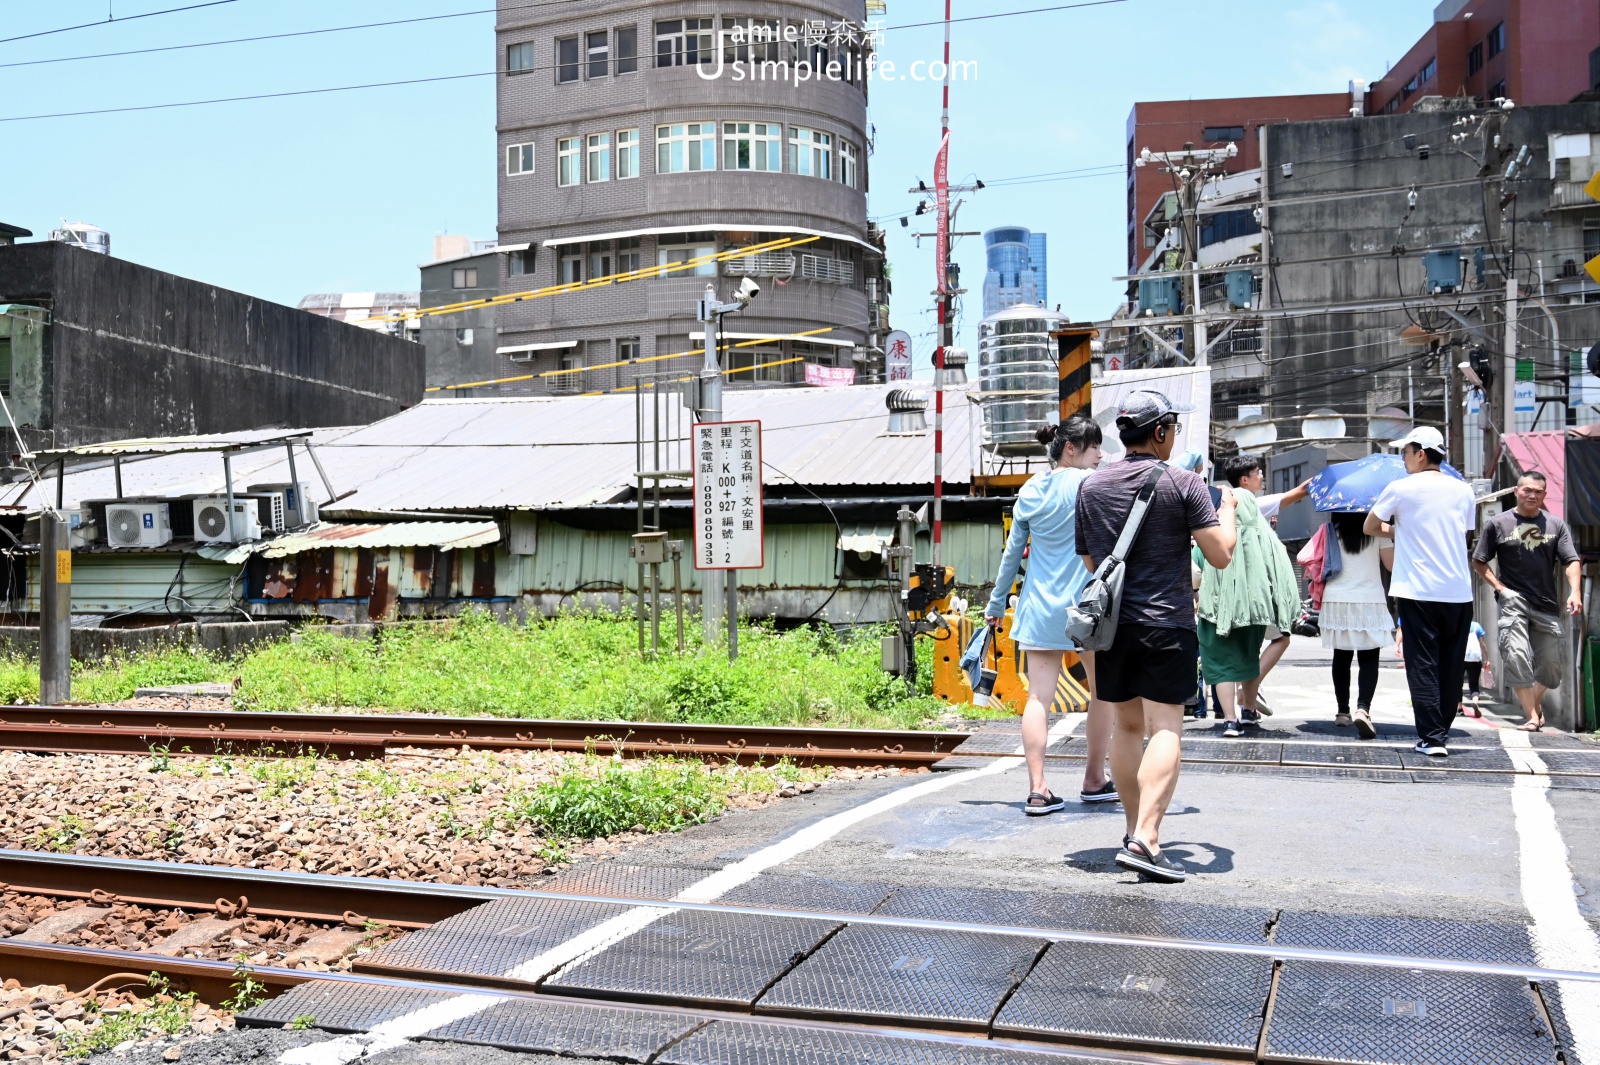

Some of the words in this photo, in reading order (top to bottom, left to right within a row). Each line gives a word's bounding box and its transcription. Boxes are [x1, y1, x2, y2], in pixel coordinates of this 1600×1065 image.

[1514, 390, 1533, 398] art
[740, 426, 754, 531] 平交道名稱：文安里
